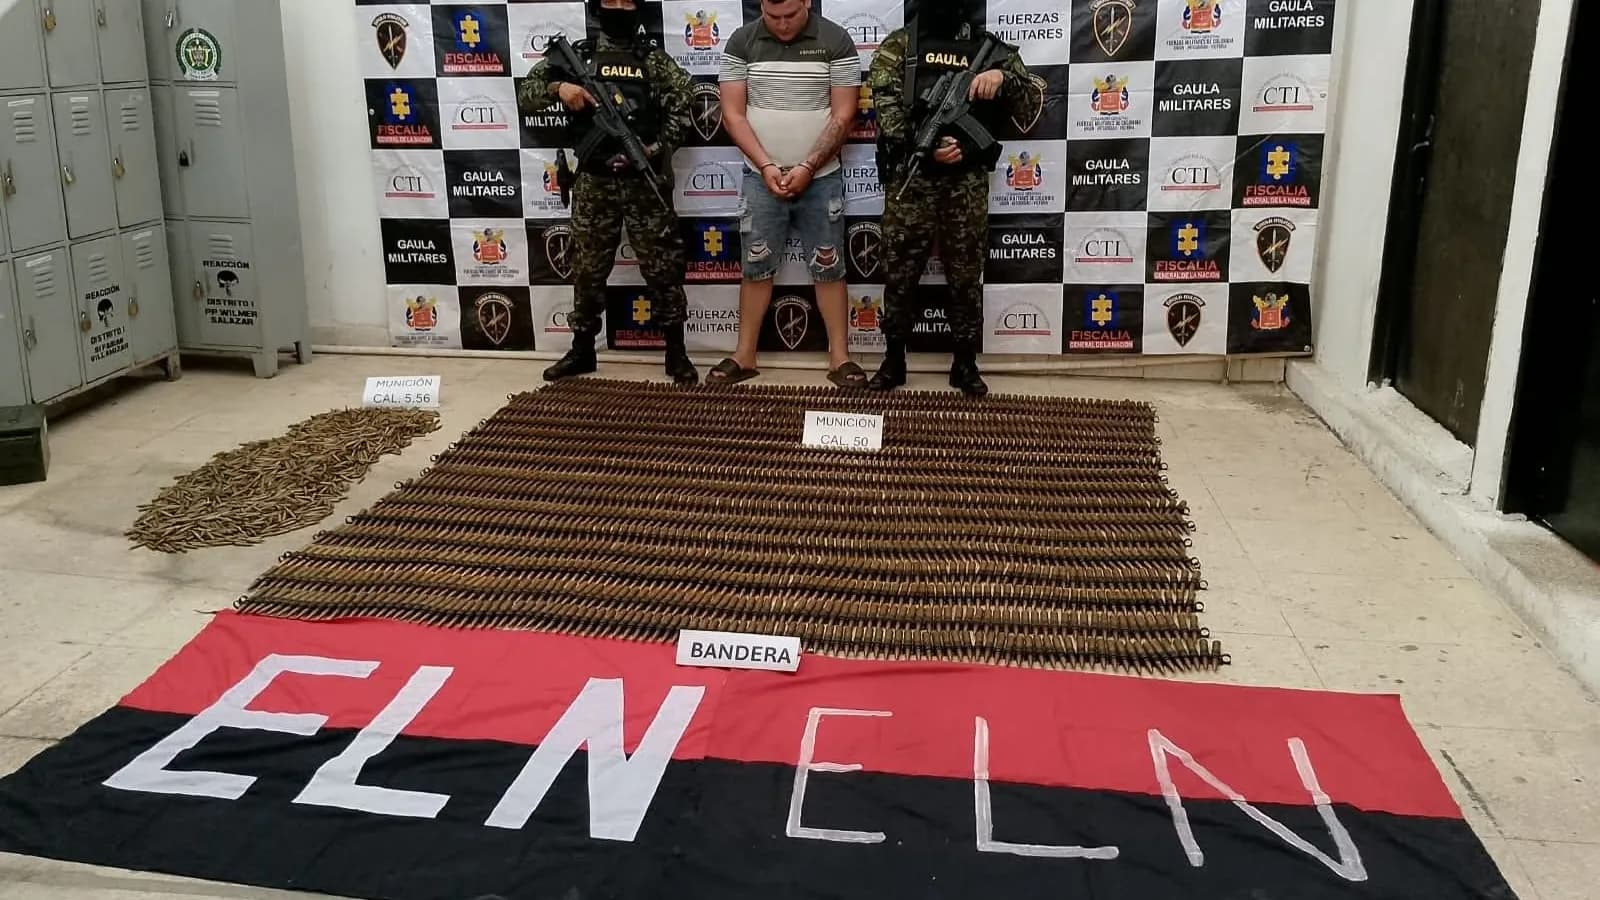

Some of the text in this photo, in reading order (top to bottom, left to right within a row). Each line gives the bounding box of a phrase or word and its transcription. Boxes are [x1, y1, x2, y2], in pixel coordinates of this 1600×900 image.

[1269, 0, 1314, 12] GAULA
[998, 12, 1059, 25] FUERZAS
[1254, 16, 1325, 30] MILITARES
[994, 28, 1063, 41] MILITARES
[445, 53, 500, 63] FISCALIA
[925, 52, 969, 68] GAULA
[601, 66, 644, 78] GAULA
[1173, 83, 1220, 95] GAULA
[1263, 86, 1300, 104] CTI
[1159, 98, 1232, 112] MILITARES
[460, 106, 496, 124] CTI
[378, 125, 430, 135] FISCALIA
[1085, 158, 1130, 170] GAULA
[463, 172, 504, 182] GAULA
[844, 168, 878, 178] UERZ
[1172, 167, 1210, 184] CTI
[392, 175, 422, 192] CTI
[692, 174, 725, 190] CTI
[1072, 174, 1141, 186] MILITARES
[452, 186, 516, 197] MILITARES
[1246, 185, 1308, 196] FISCALIA
[397, 240, 436, 250] GAULA
[1002, 234, 1045, 244] GAULA
[990, 248, 1056, 259] MILITARES
[1085, 240, 1121, 256] CTI
[388, 252, 447, 264] MILITARES
[687, 262, 740, 271] FISCALIA
[1156, 260, 1217, 270] FISCALIA
[207, 298, 249, 307] DISTRITO
[219, 309, 257, 318] WILMER
[210, 316, 254, 325] SALAZAR
[1004, 313, 1038, 329] CTI
[687, 323, 740, 332] MILITARE
[912, 322, 952, 332] MILITA
[90, 327, 122, 344] DISTRITO
[1072, 330, 1130, 340] FISCALIA
[376, 378, 432, 388] MUNICIÓN
[373, 394, 431, 404] CAL. 5.56
[816, 415, 876, 428] MUNICIÓN
[820, 435, 869, 447] CAL. 50
[690, 642, 791, 664] BANDERA
[101, 652, 1368, 882] ELN ELN
